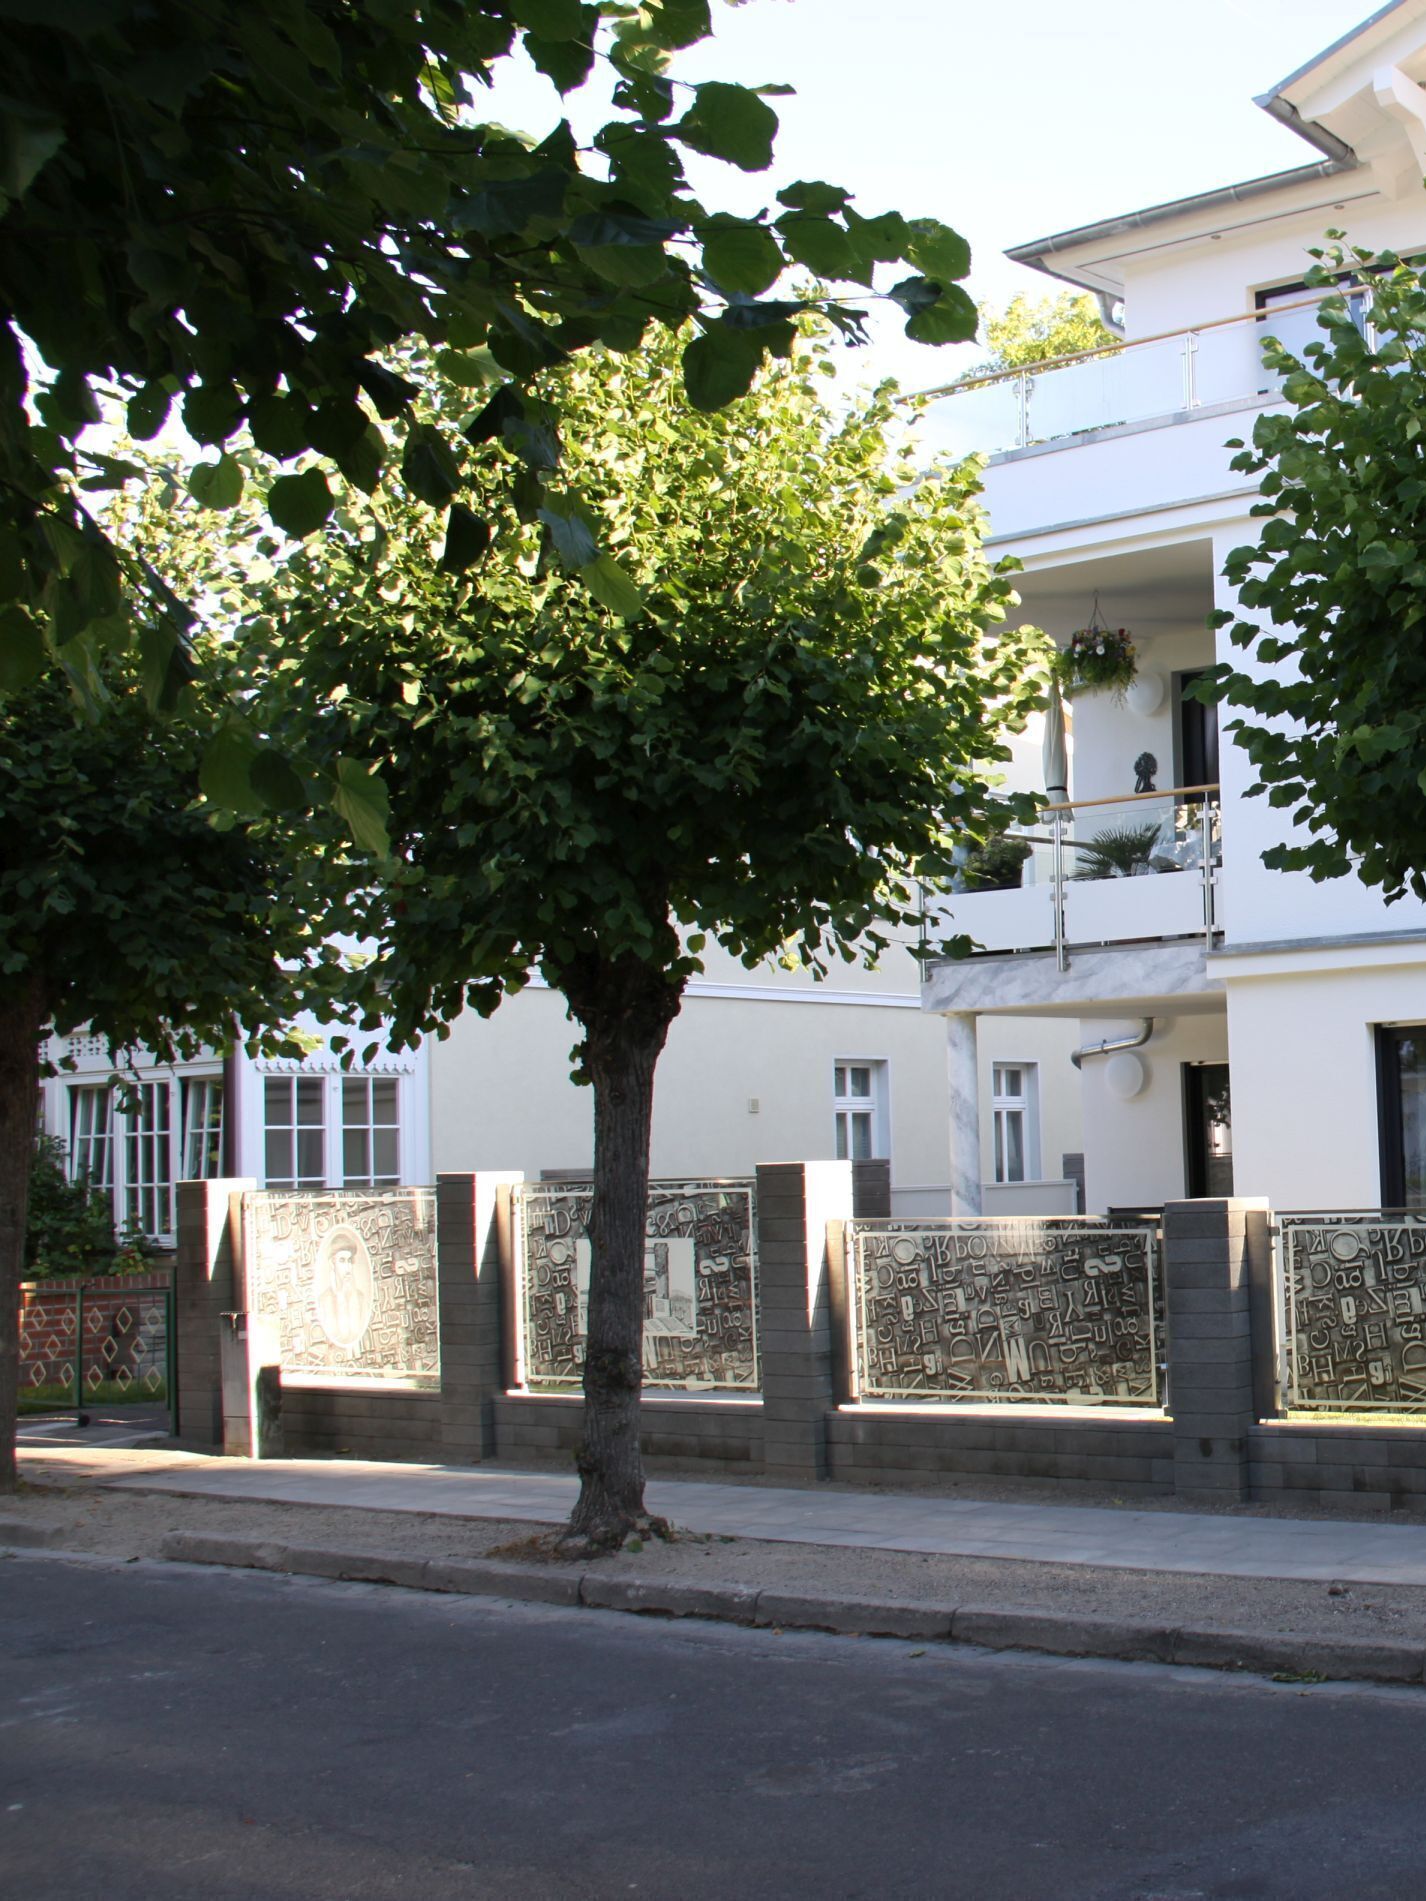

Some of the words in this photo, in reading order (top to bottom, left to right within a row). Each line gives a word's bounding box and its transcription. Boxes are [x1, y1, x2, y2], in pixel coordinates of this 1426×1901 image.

[968, 1235, 986, 1258] O
[919, 1319, 939, 1343] H
[1364, 1322, 1388, 1349] H
[879, 1348, 898, 1372] H
[1312, 1355, 1336, 1382] H
